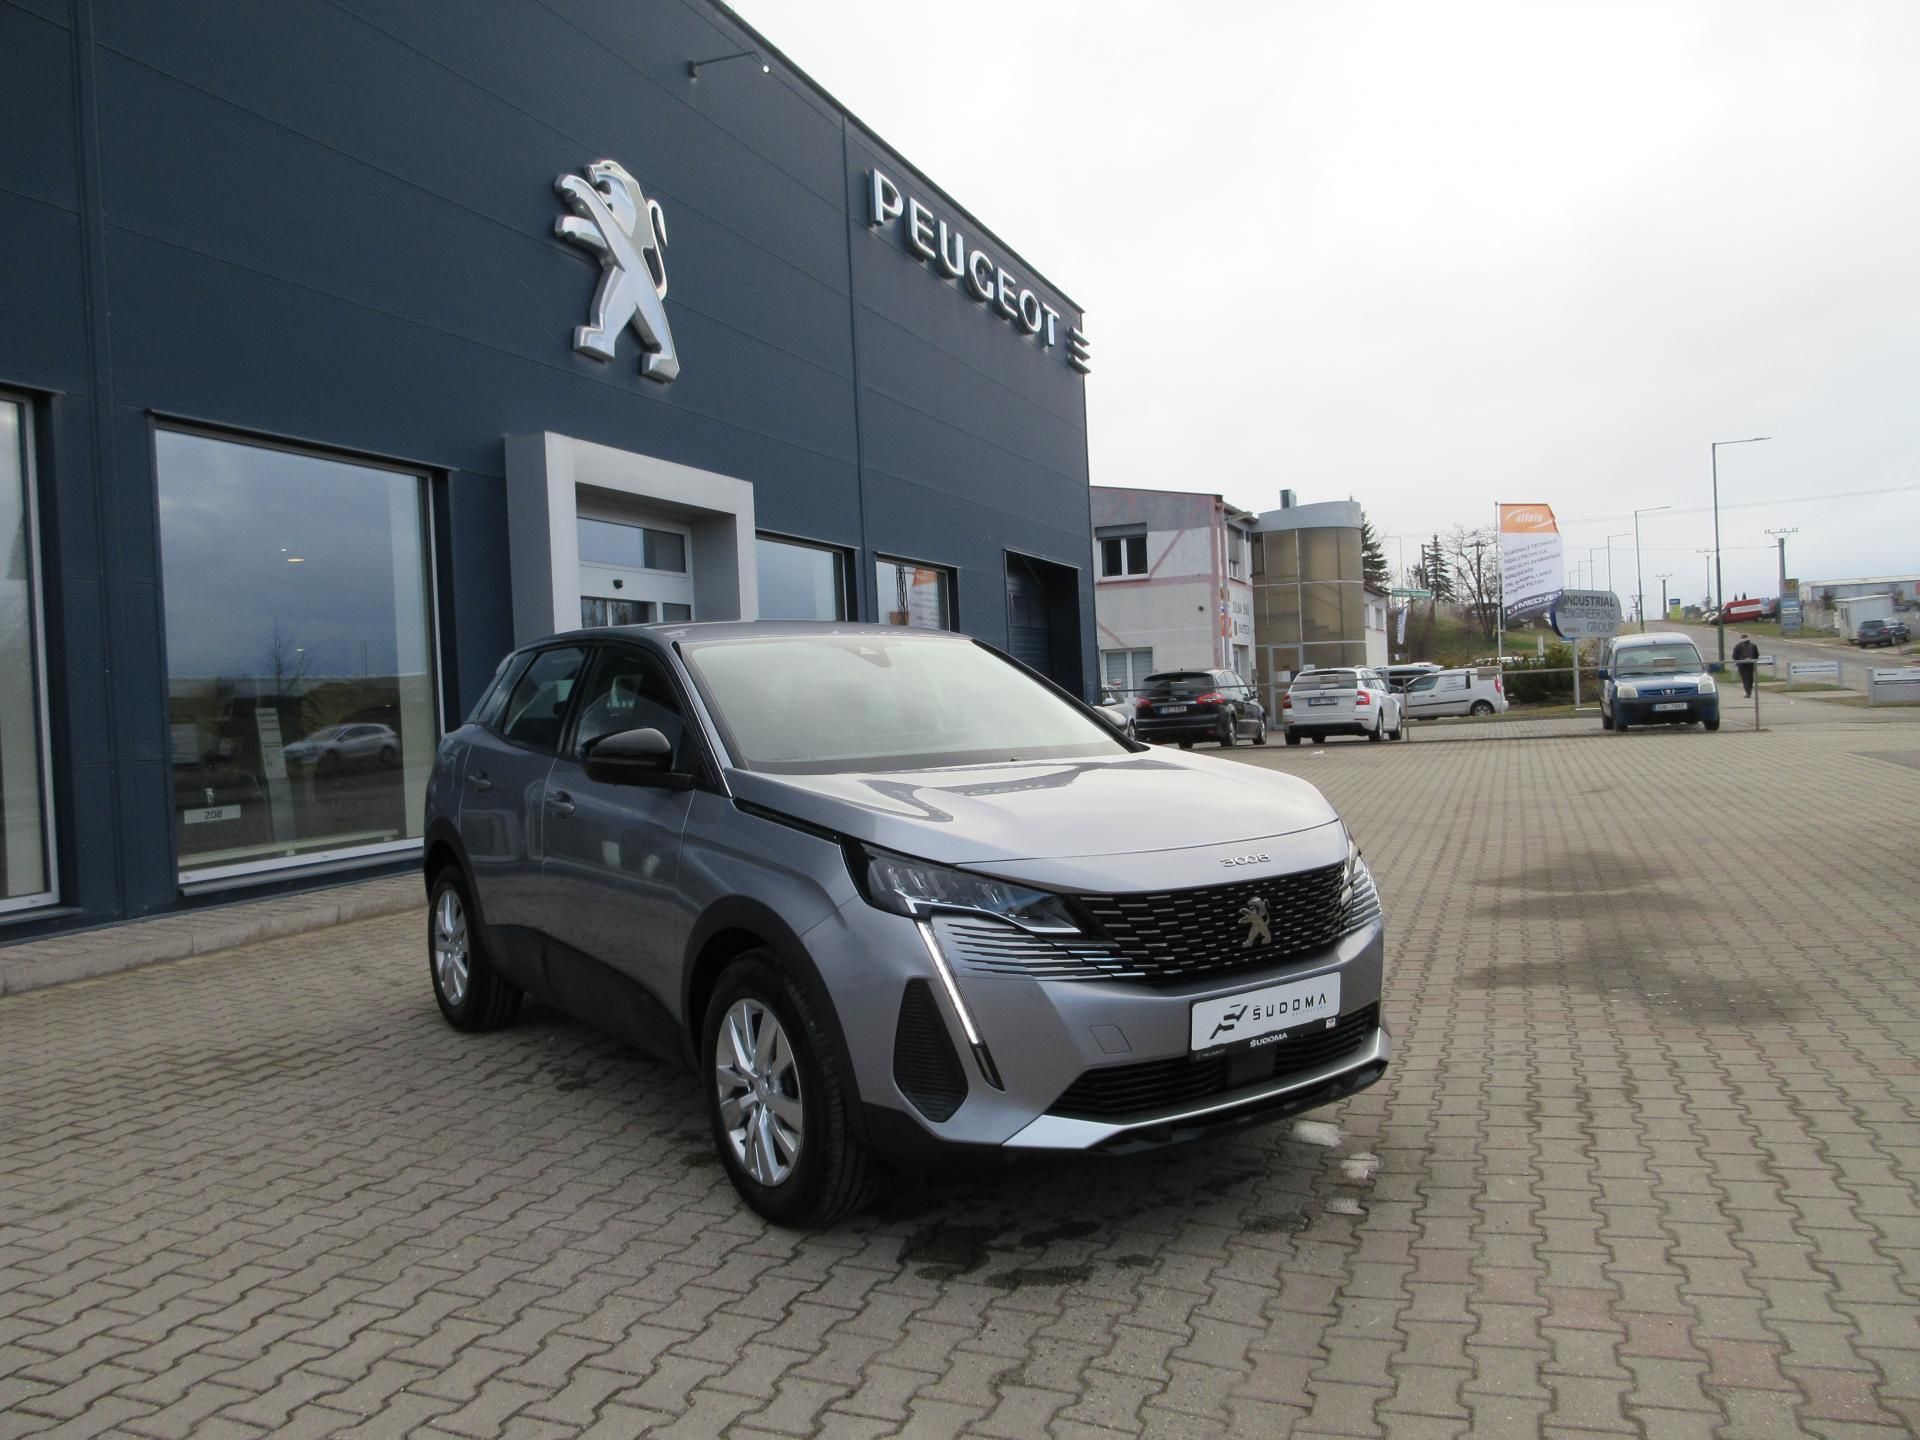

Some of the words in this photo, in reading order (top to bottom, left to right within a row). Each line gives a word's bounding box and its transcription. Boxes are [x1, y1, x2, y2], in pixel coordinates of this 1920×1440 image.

[868, 167, 1060, 347] PEUGEOT
[1563, 595, 1615, 608] INDUSTRIAL
[1562, 608, 1616, 620] ENGINEERING
[1586, 621, 1615, 633] GROUP
[205, 810, 224, 820] 208
[1219, 853, 1272, 868] 3008
